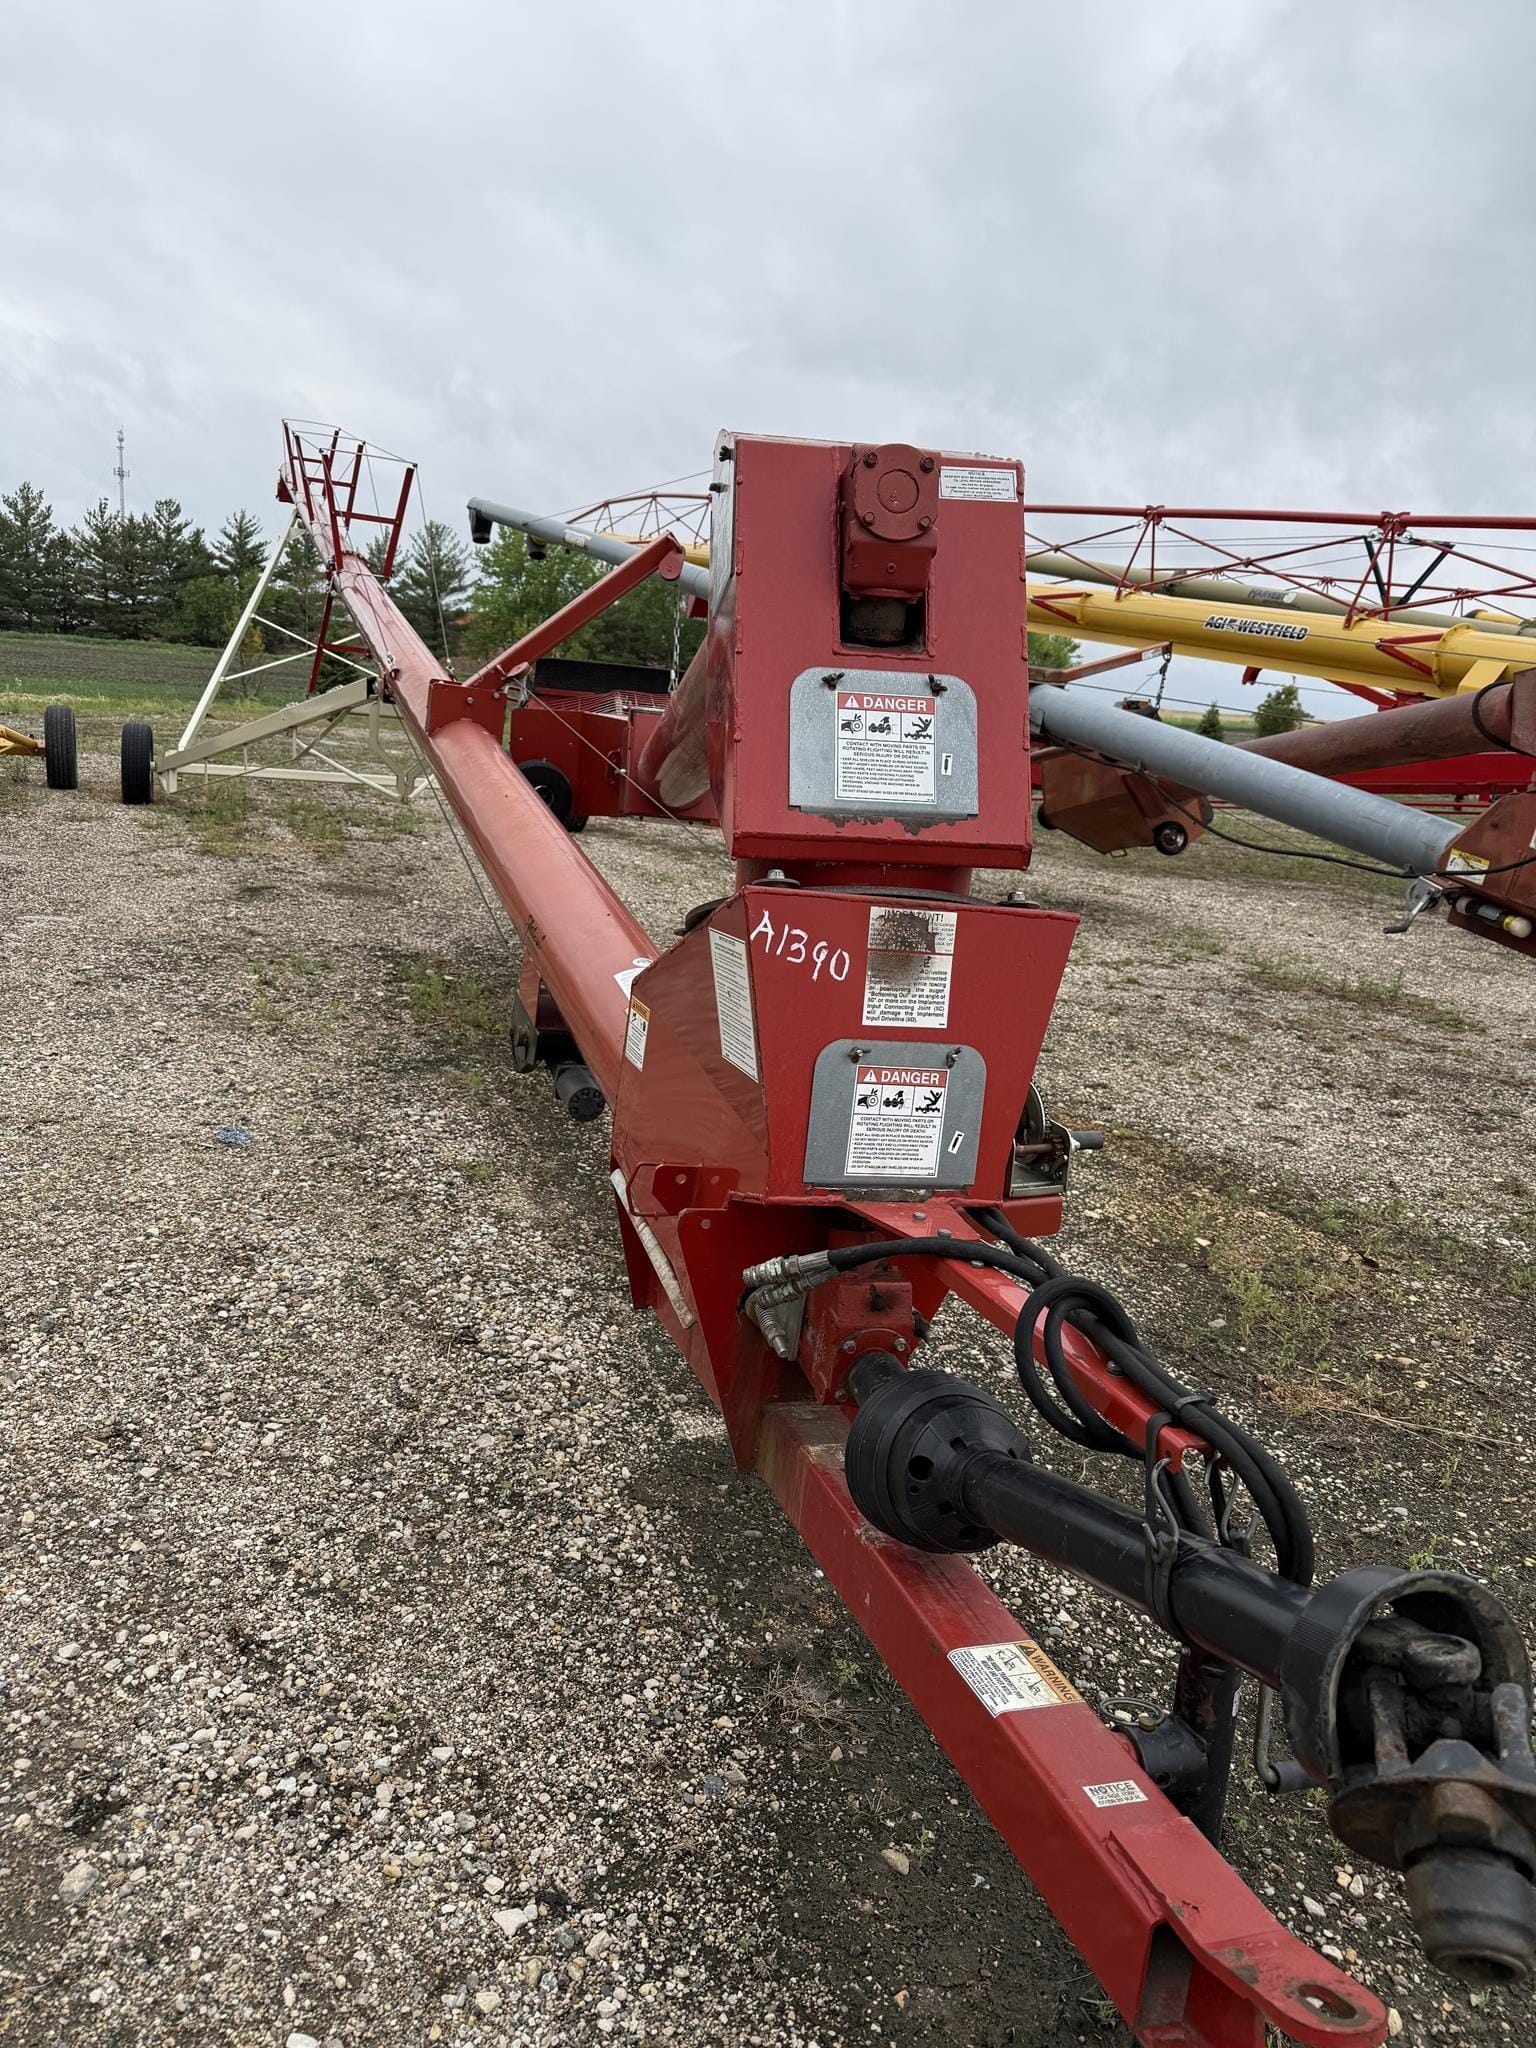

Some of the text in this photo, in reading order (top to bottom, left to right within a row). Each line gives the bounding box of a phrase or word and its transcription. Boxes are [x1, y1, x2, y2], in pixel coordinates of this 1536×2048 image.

[1204, 616, 1308, 640] AGI WESTFIELD
[863, 697, 927, 711] DANGER
[750, 909, 850, 981] A1390
[881, 1071, 940, 1085] DANGER
[1033, 1655, 1076, 1701] WARNING
[1089, 1782, 1135, 1796] NOTICE
